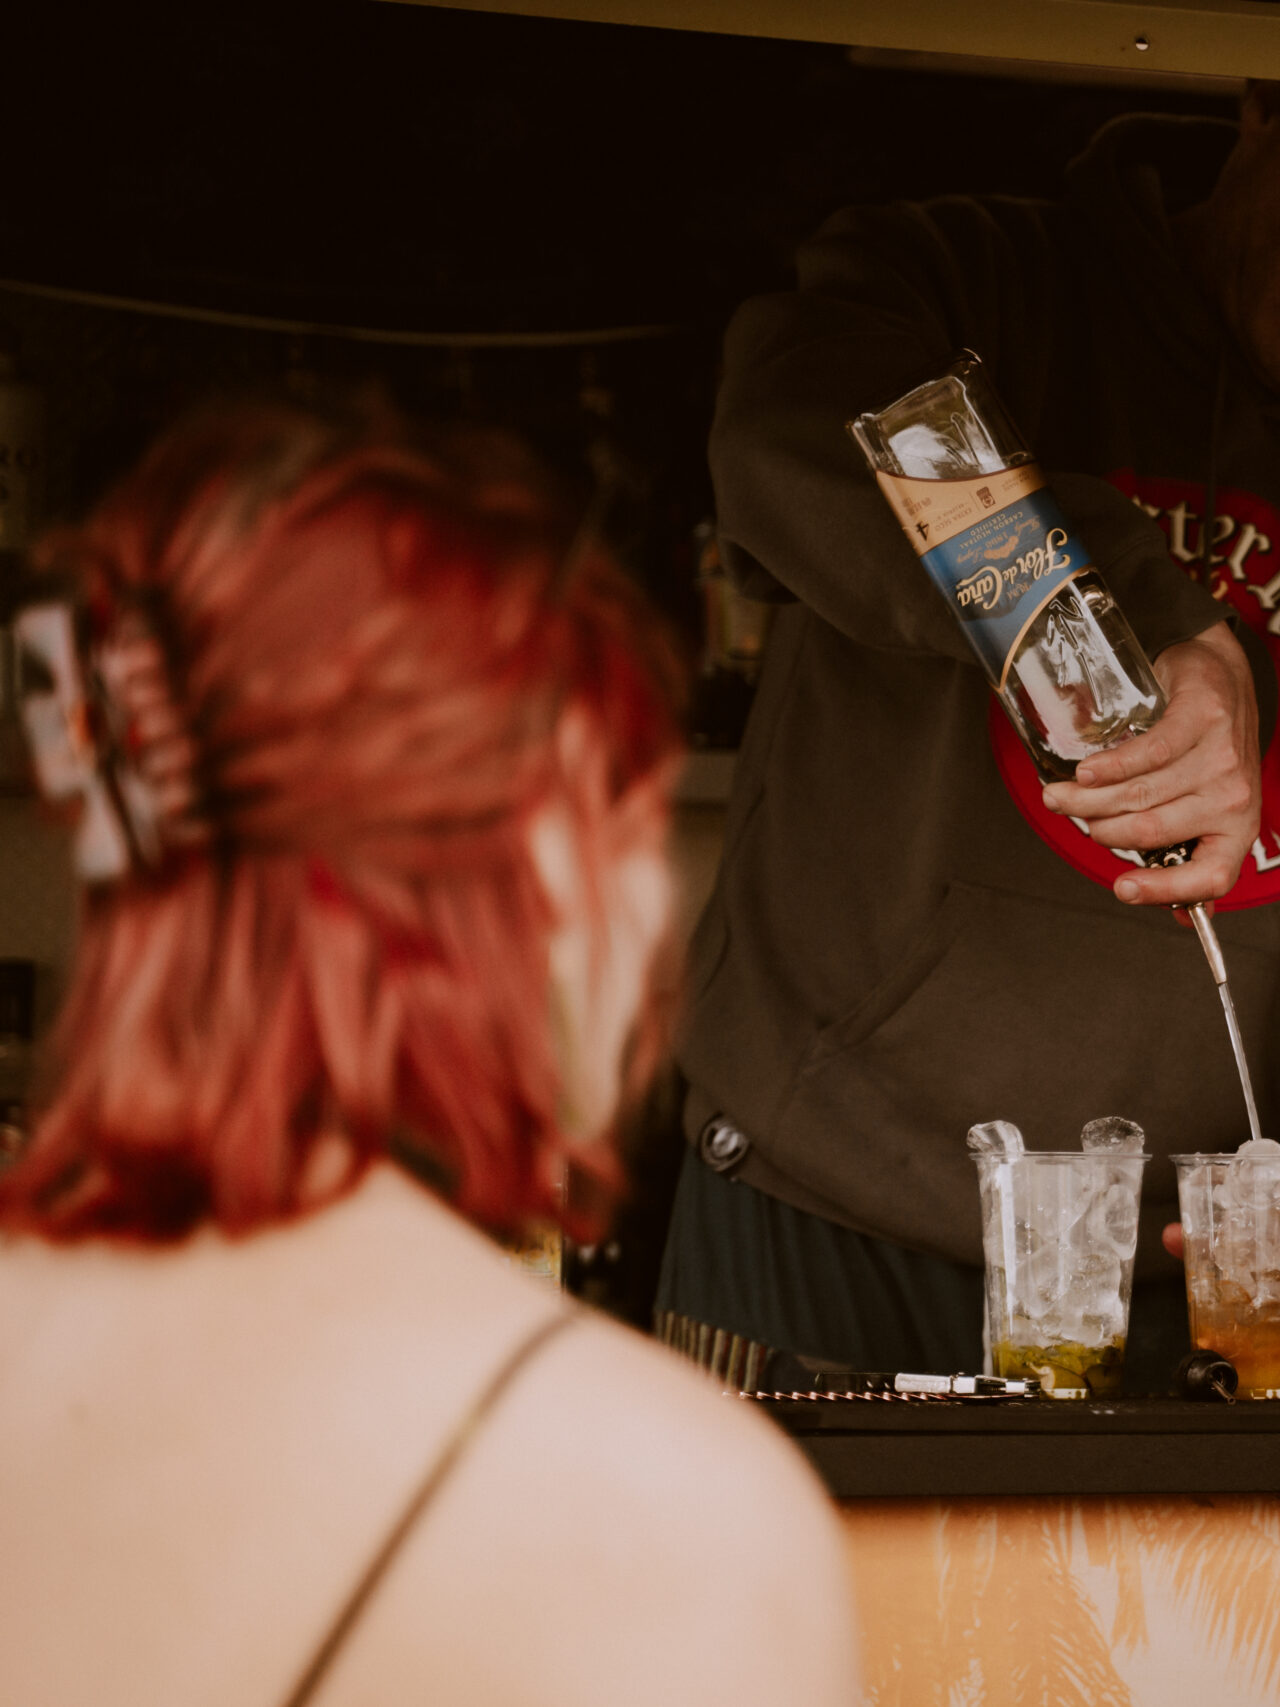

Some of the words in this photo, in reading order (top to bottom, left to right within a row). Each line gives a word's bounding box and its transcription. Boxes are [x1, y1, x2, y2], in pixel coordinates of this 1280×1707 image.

[1002, 565, 1018, 585] de
[1016, 527, 1071, 581] Flor
[955, 565, 1003, 610] Caña
